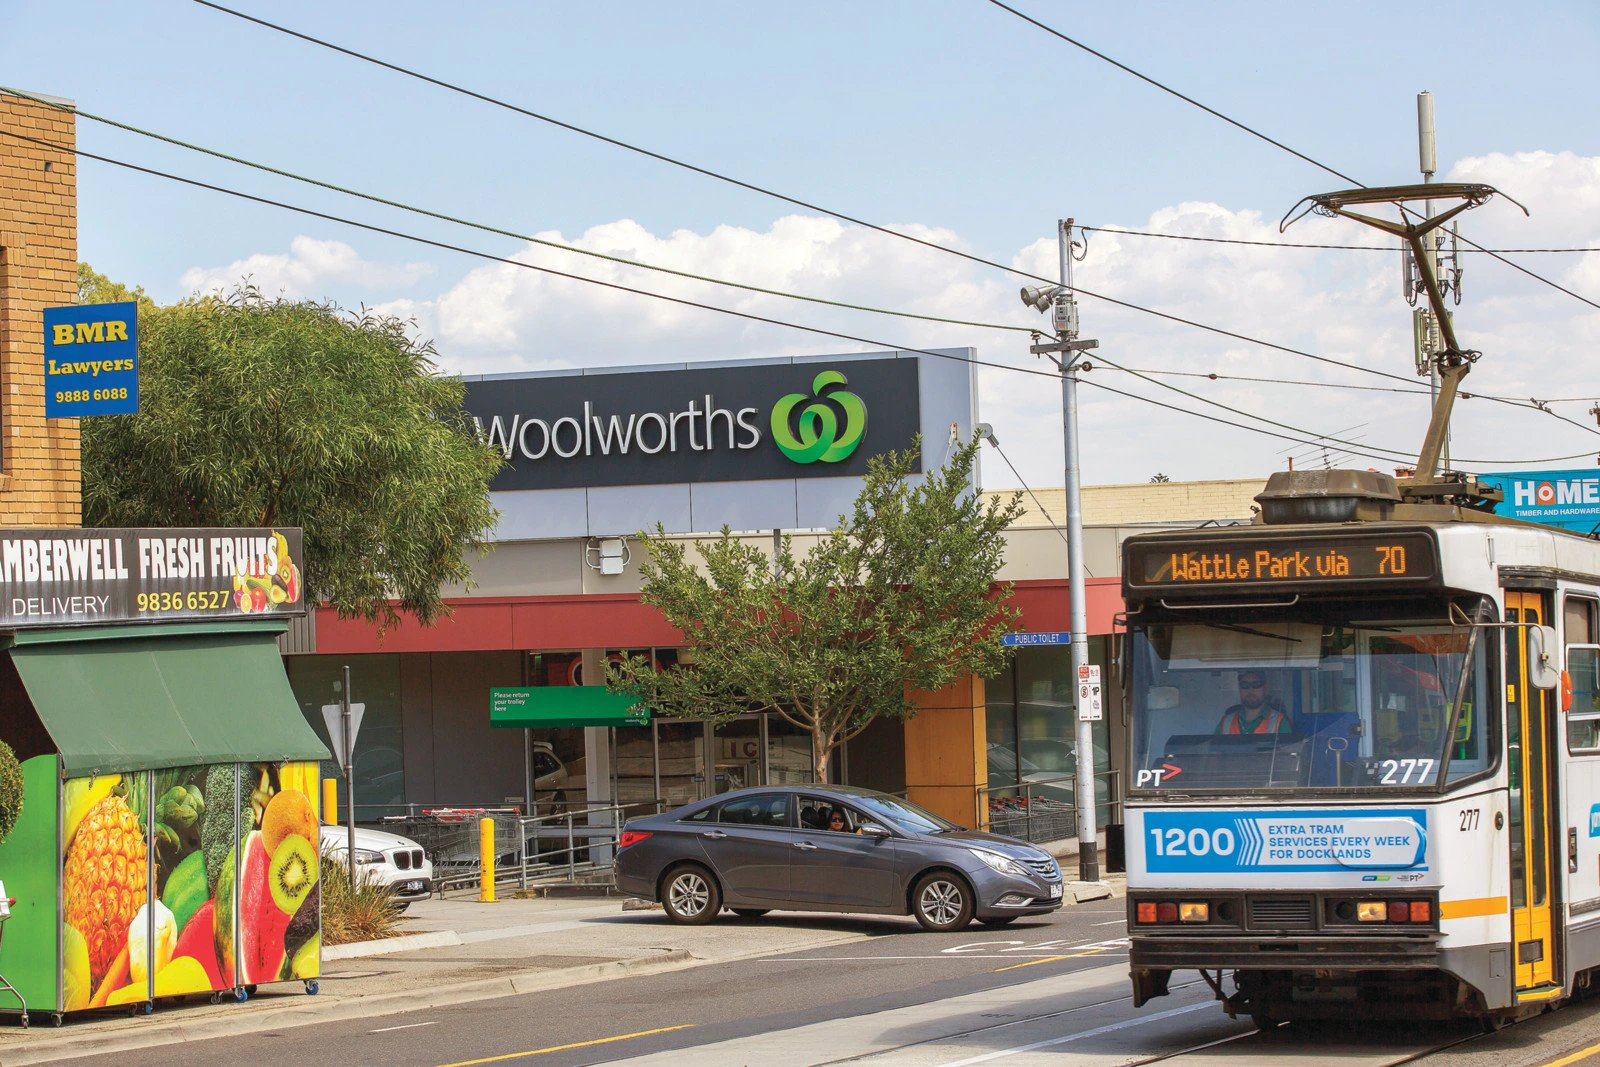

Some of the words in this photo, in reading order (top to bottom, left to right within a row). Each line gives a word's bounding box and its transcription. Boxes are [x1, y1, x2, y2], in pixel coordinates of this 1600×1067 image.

[53, 321, 128, 345] BMR
[48, 359, 134, 376] Lawyers
[55, 389, 90, 402] 9888
[93, 387, 128, 400] 6088
[473, 395, 761, 460] woolworths
[1514, 479, 1600, 506] HOME
[0, 538, 128, 582] MBERWELL
[139, 537, 205, 579] FRESH
[210, 537, 278, 578] FRUITS
[1171, 552, 1250, 580] Wattle
[1255, 551, 1311, 578] Park
[1316, 550, 1349, 576] via
[1375, 546, 1406, 574] 70
[12, 595, 109, 616] DELIVERY
[137, 592, 183, 612] 9836
[187, 590, 230, 610] 6527
[1014, 634, 1037, 644] PUBLIC
[1038, 633, 1060, 643] TOILET
[494, 703, 507, 711] here
[507, 698, 526, 706] trolley
[1380, 759, 1434, 784] 277
[1268, 825, 1306, 835] EXTRA
[1310, 824, 1344, 834] TRAM
[1460, 808, 1480, 831] 277
[1150, 828, 1235, 856] 1200
[1269, 837, 1328, 847] SERVICES
[1332, 837, 1371, 846] EVERY
[1374, 836, 1410, 846] WEEK
[1270, 850, 1293, 859] FOR
[1297, 849, 1371, 859] DOCKLANDS
